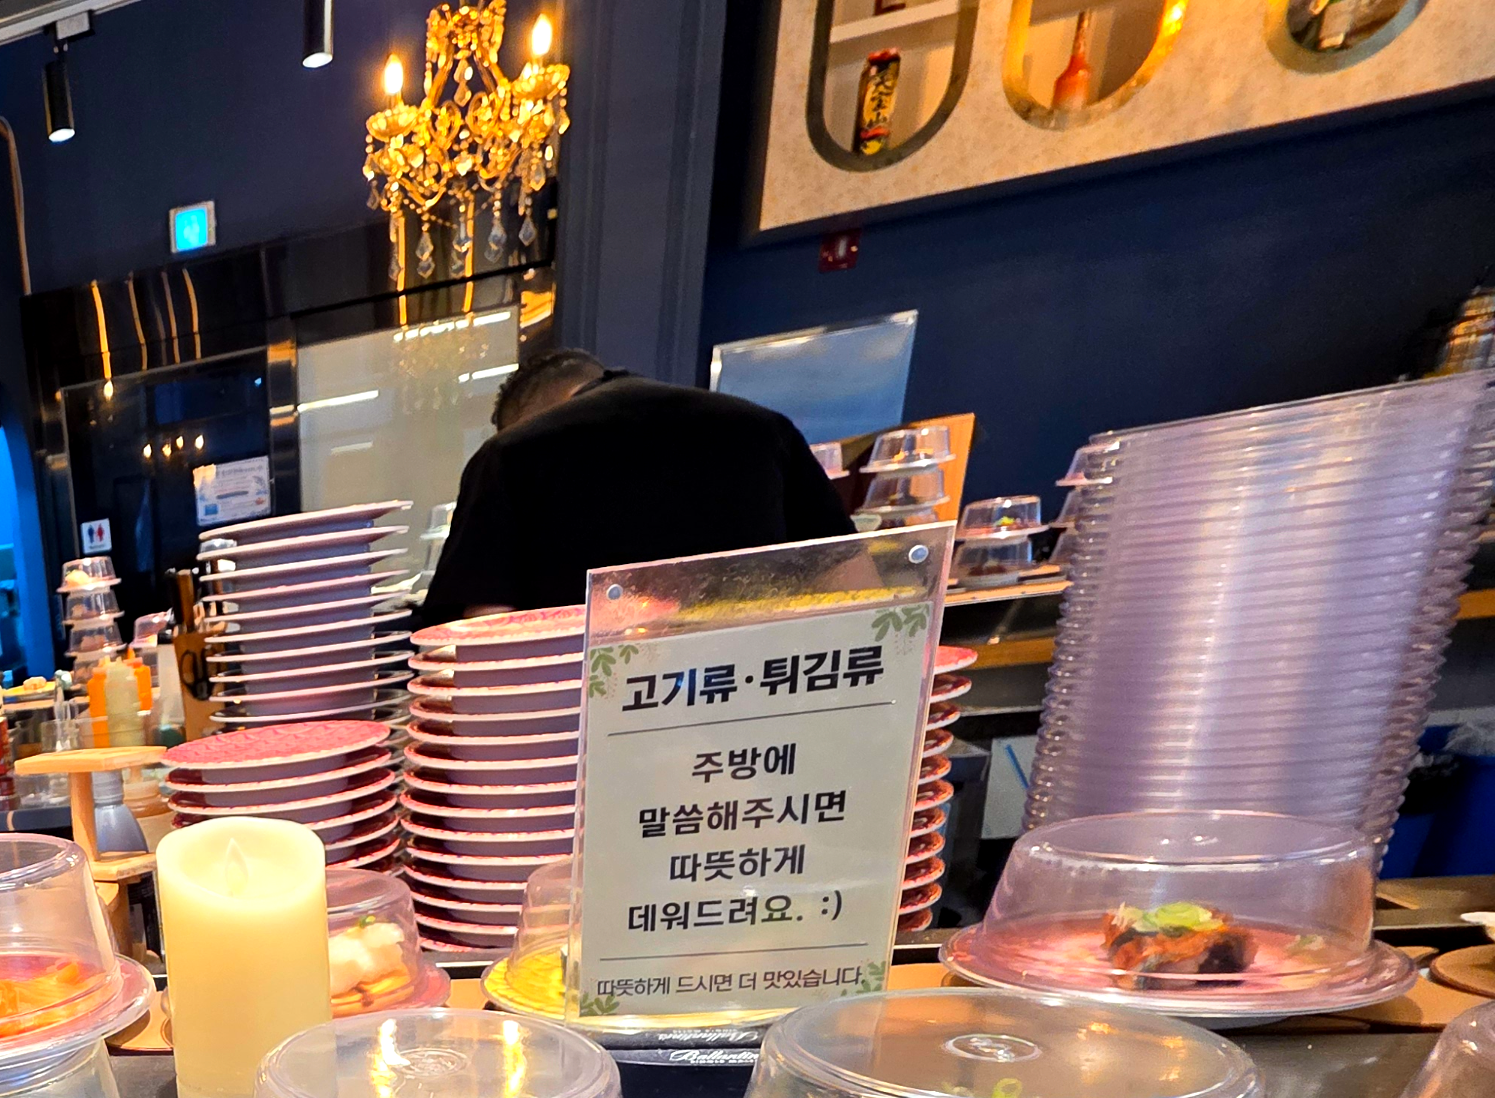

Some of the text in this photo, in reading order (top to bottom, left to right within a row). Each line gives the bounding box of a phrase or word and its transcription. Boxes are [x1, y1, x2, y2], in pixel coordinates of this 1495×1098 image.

[692, 743, 797, 784] 주방에
[639, 790, 847, 839] 말씀해주시면
[670, 843, 806, 884] 따뜻하게
[628, 896, 805, 932] 데워드려요.
[597, 976, 671, 997] 따뜻하게
[676, 974, 733, 994] 드시면
[739, 972, 756, 991] 더
